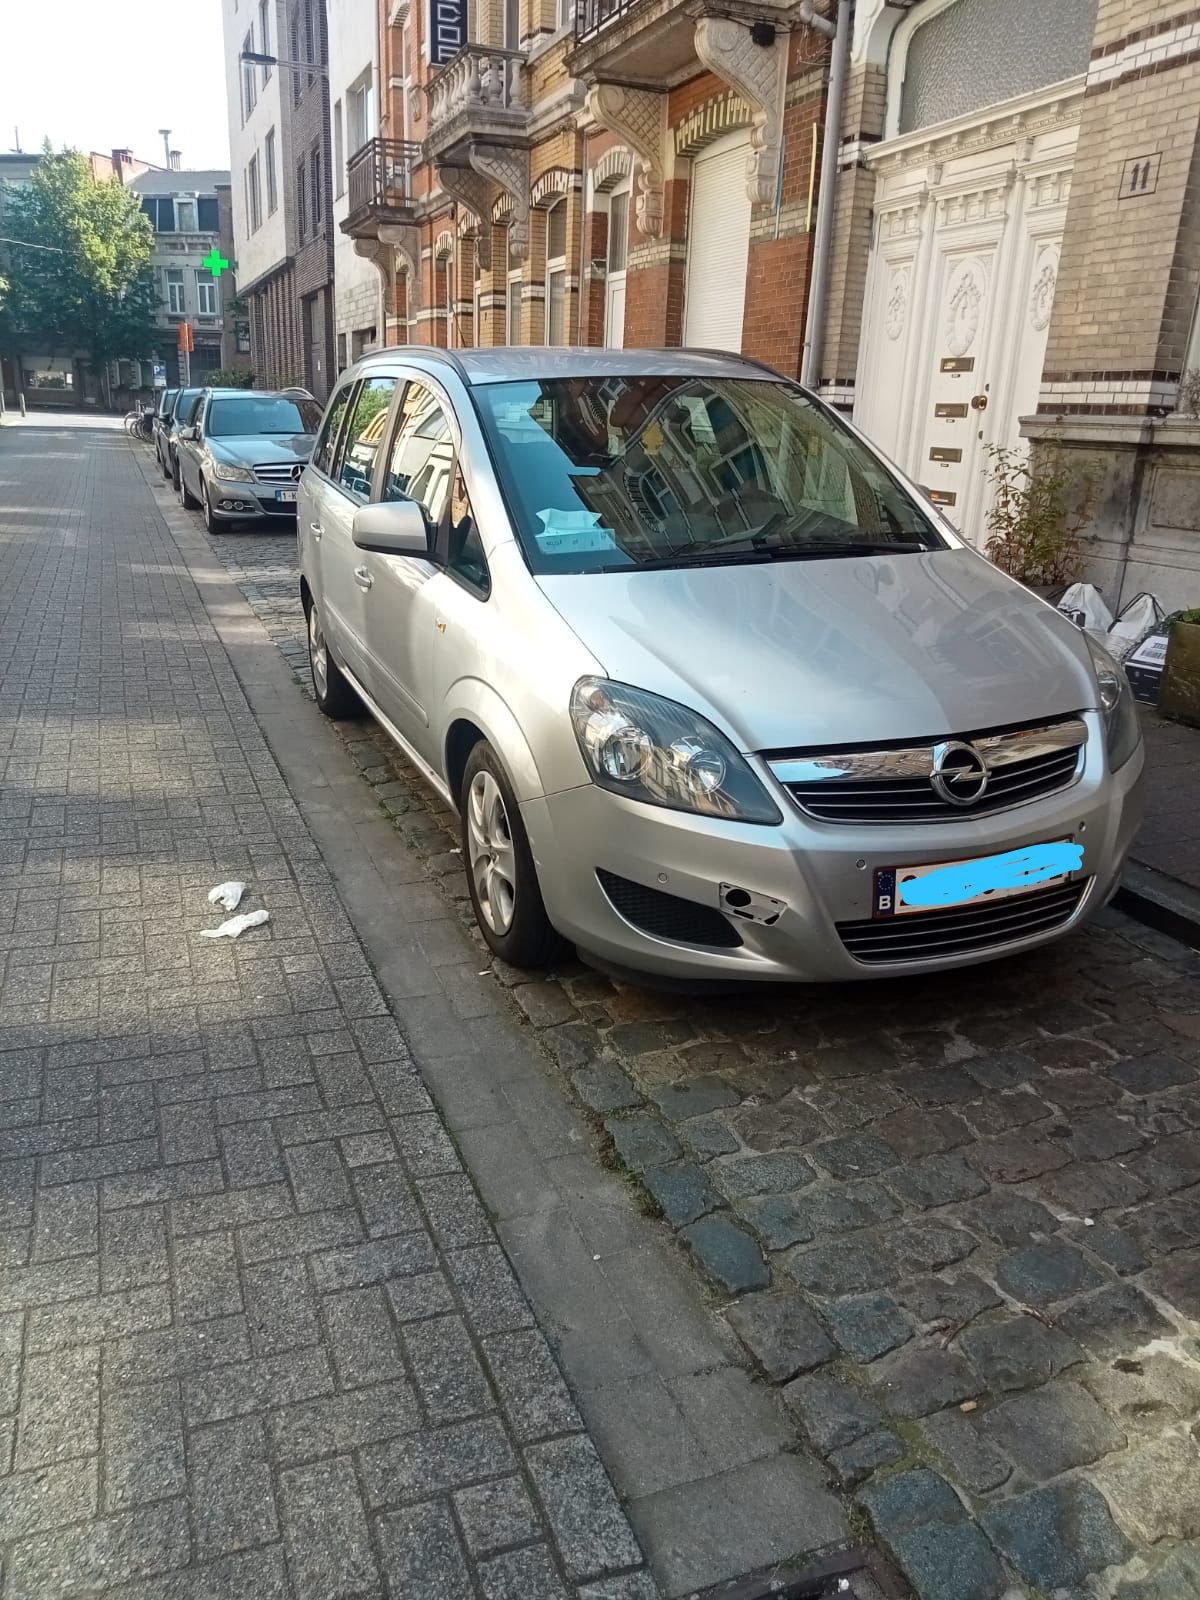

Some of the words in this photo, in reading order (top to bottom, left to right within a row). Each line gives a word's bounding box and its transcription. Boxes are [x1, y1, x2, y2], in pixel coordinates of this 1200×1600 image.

[1130, 161, 1151, 192] 11
[153, 365, 160, 375] P
[878, 895, 891, 910] B
